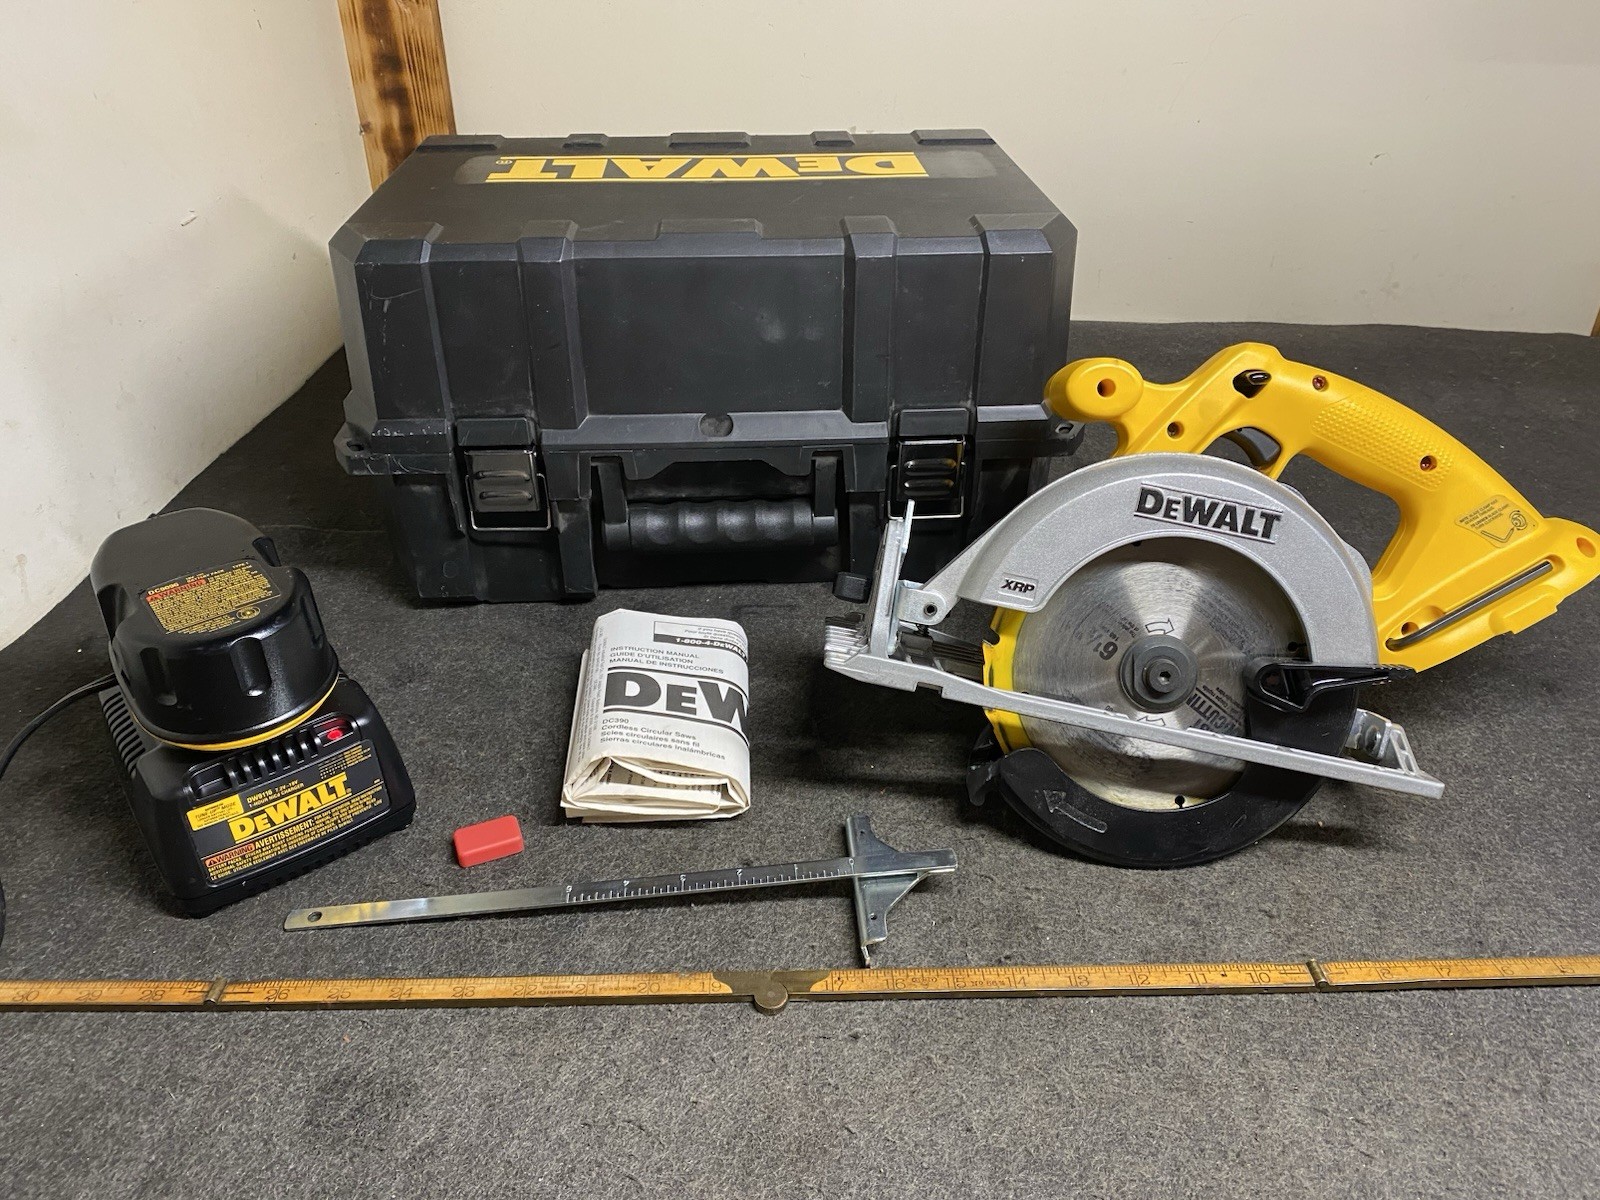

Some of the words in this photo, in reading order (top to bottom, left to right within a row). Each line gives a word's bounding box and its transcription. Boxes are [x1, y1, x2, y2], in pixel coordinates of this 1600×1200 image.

[497, 154, 925, 178] DEWALT
[1137, 486, 1282, 540] DEWALT
[1000, 578, 1036, 594] XRP
[610, 645, 665, 655] INSTRUCTION
[666, 650, 700, 659] MANUAL
[637, 653, 694, 664] D'UTILISATION
[659, 661, 724, 674] INSTRUCCIONES
[601, 724, 638, 732] Cordless
[640, 727, 673, 736] Circular
[675, 731, 697, 740] Saws
[625, 732, 671, 742] circulaires
[671, 738, 691, 746] sans
[632, 739, 673, 749] circulares
[228, 776, 348, 841] DEWALT
[217, 845, 253, 862] WARNING
[254, 819, 315, 849] AVERTISSEMENT:
[636, 982, 661, 994] 20
[700, 981, 722, 993] 19
[822, 979, 844, 992] 17
[885, 978, 907, 990] 16
[943, 977, 967, 989] 15
[1005, 976, 1028, 988] 14
[1067, 975, 1090, 987] 13
[1129, 973, 1151, 986] 12
[1188, 972, 1210, 985] 11
[1249, 971, 1272, 984] 10
[138, 989, 166, 1001] 28
[264, 988, 291, 1002] 26
[326, 987, 352, 1000] 25
[389, 986, 413, 999] 24
[512, 983, 538, 998] 22
[574, 983, 596, 996] 21
